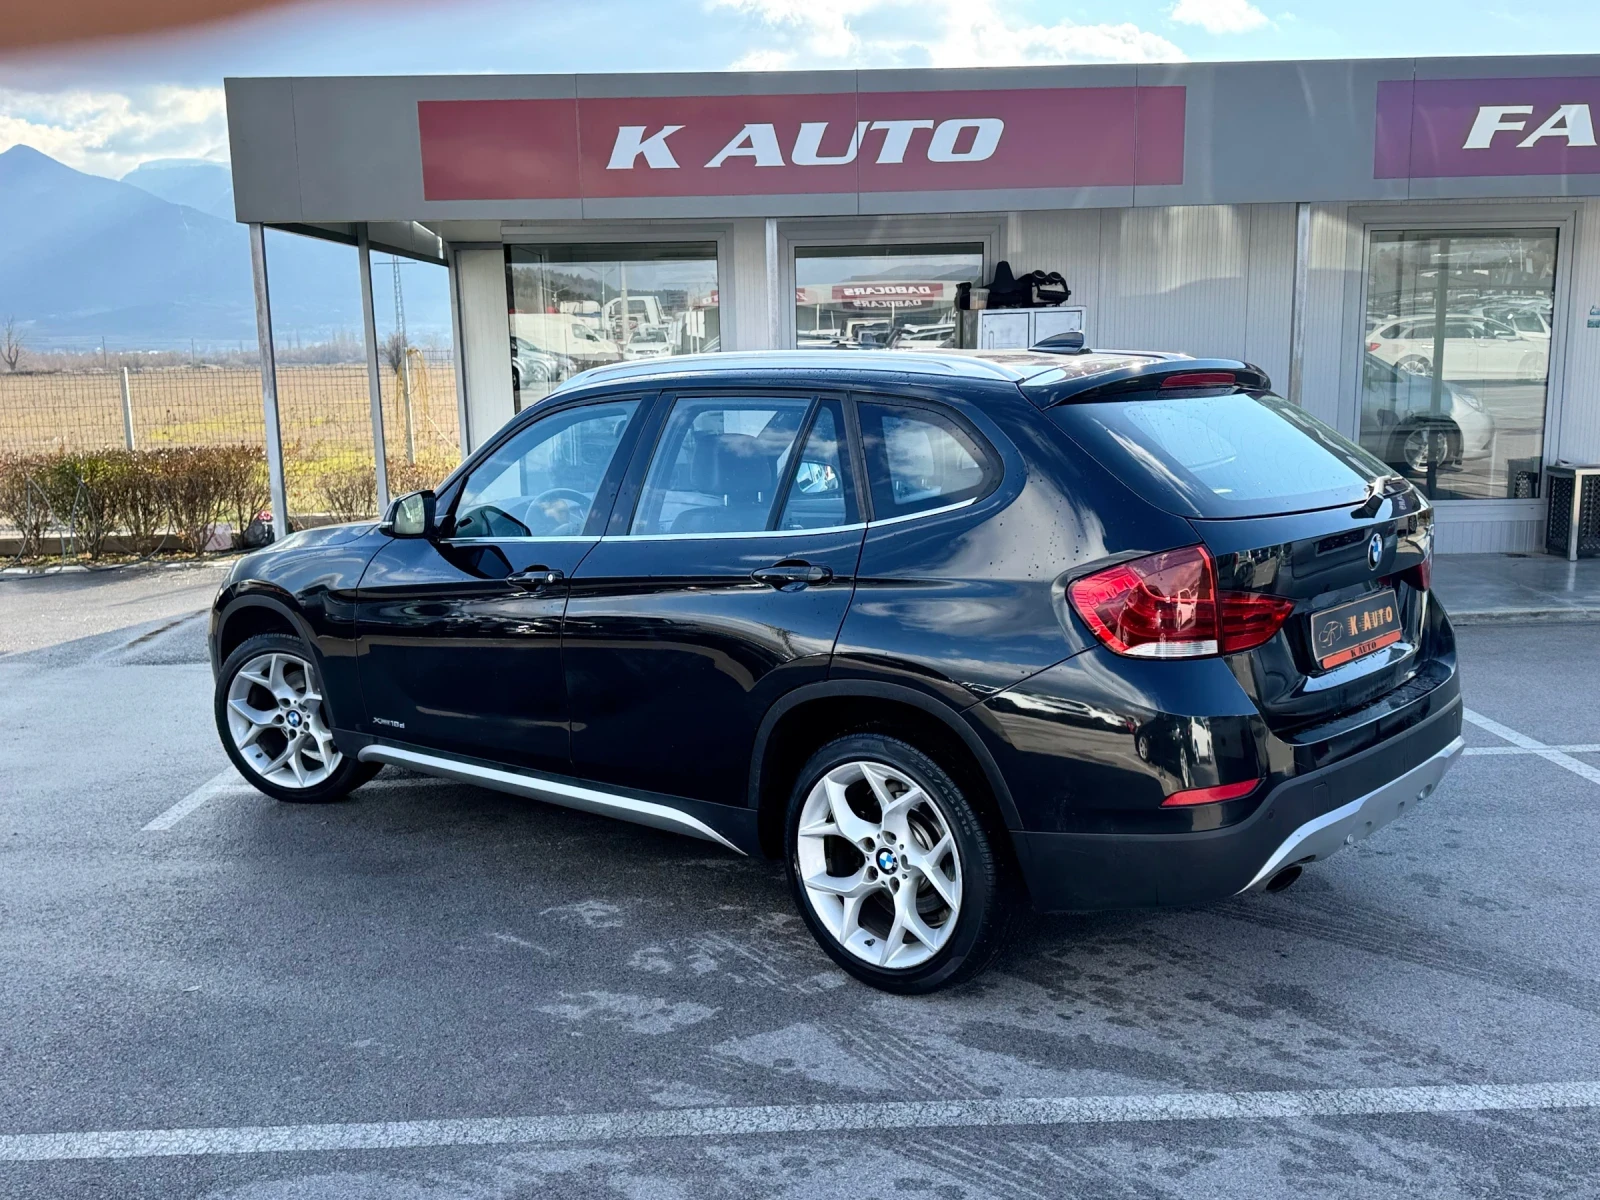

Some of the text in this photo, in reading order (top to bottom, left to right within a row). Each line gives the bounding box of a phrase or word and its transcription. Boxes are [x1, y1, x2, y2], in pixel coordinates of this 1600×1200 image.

[1462, 104, 1598, 149] FA
[606, 118, 1004, 170] K AUTO
[1350, 616, 1358, 635] K
[1359, 642, 1376, 655] AUTO
